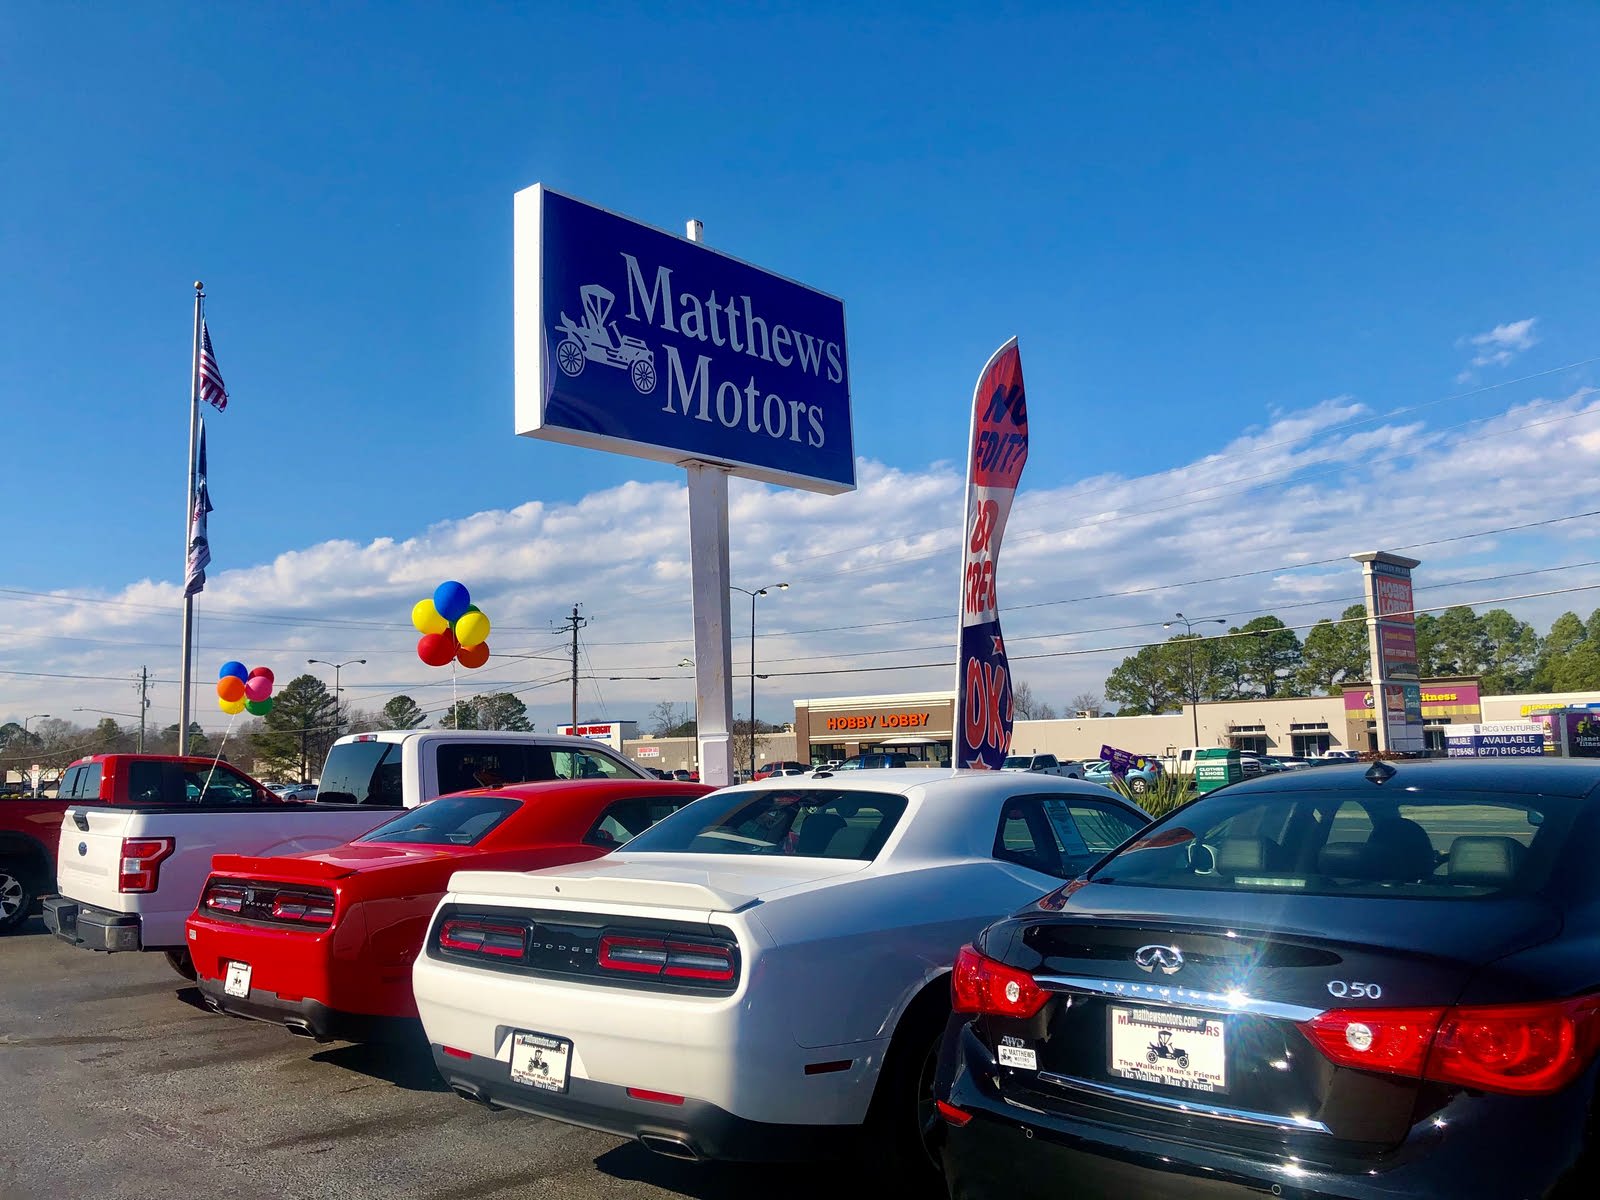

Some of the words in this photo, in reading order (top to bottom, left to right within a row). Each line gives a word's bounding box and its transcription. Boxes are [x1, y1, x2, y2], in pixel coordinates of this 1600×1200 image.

[619, 252, 843, 384] Matthews
[661, 344, 825, 449] Motors
[1379, 580, 1410, 601] HOBBY
[826, 716, 876, 730] HOBBY
[879, 713, 929, 727] LOBBY
[1482, 725, 1499, 733] RCG
[1500, 724, 1541, 732] VENTURES
[1448, 737, 1471, 745] AVAILABLE
[1482, 735, 1535, 744] AVAILABLE
[1575, 735, 1599, 743] planet
[1478, 747, 1499, 757] (877)
[1500, 746, 1541, 755] 816-5454
[533, 942, 593, 954] DODGE
[1326, 980, 1382, 1000] Q50
[1118, 1059, 1134, 1067] The
[1135, 1061, 1165, 1072] Walkin'
[1166, 1066, 1191, 1076] Man's
[1193, 1070, 1221, 1081] Friend
[1188, 1079, 1214, 1092] Friend
